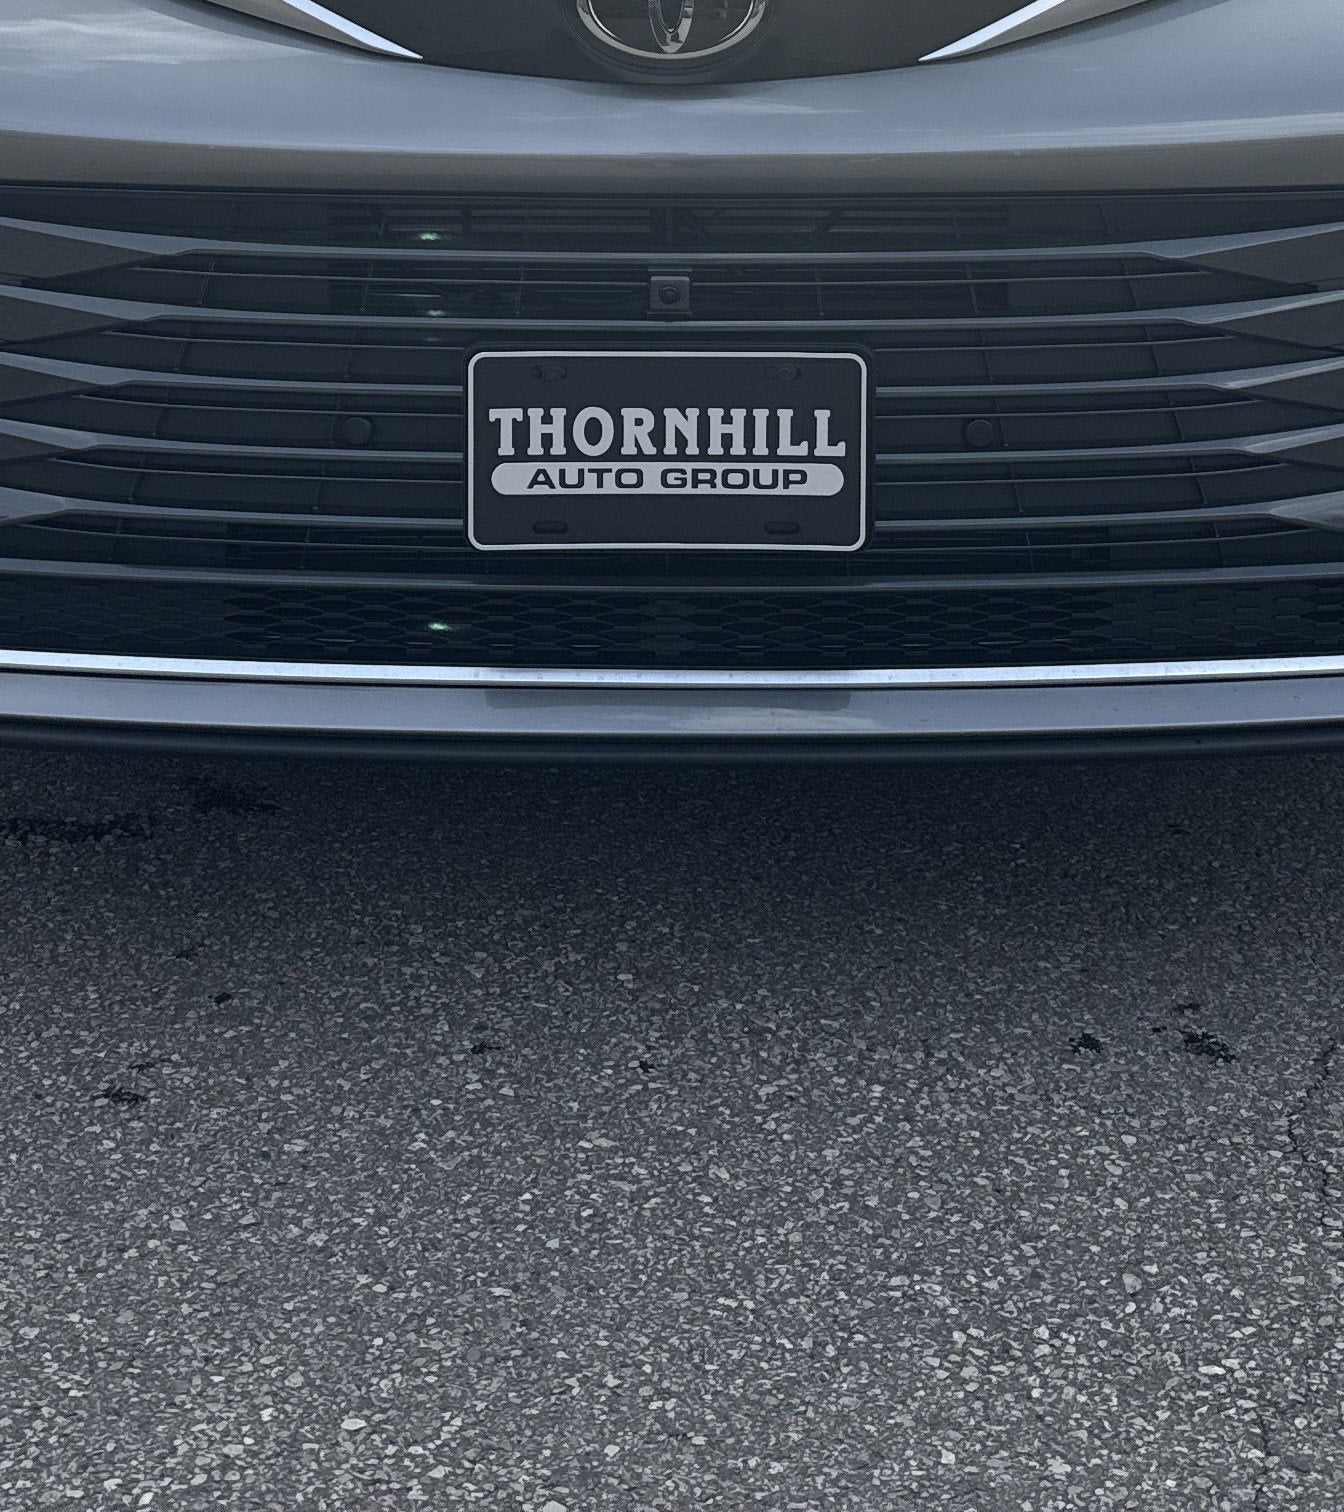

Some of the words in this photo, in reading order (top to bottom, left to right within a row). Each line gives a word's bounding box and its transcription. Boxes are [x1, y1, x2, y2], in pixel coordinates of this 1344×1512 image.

[488, 406, 846, 457] THORNHILL
[527, 467, 644, 490] AUTO
[661, 467, 809, 490] GROUP
